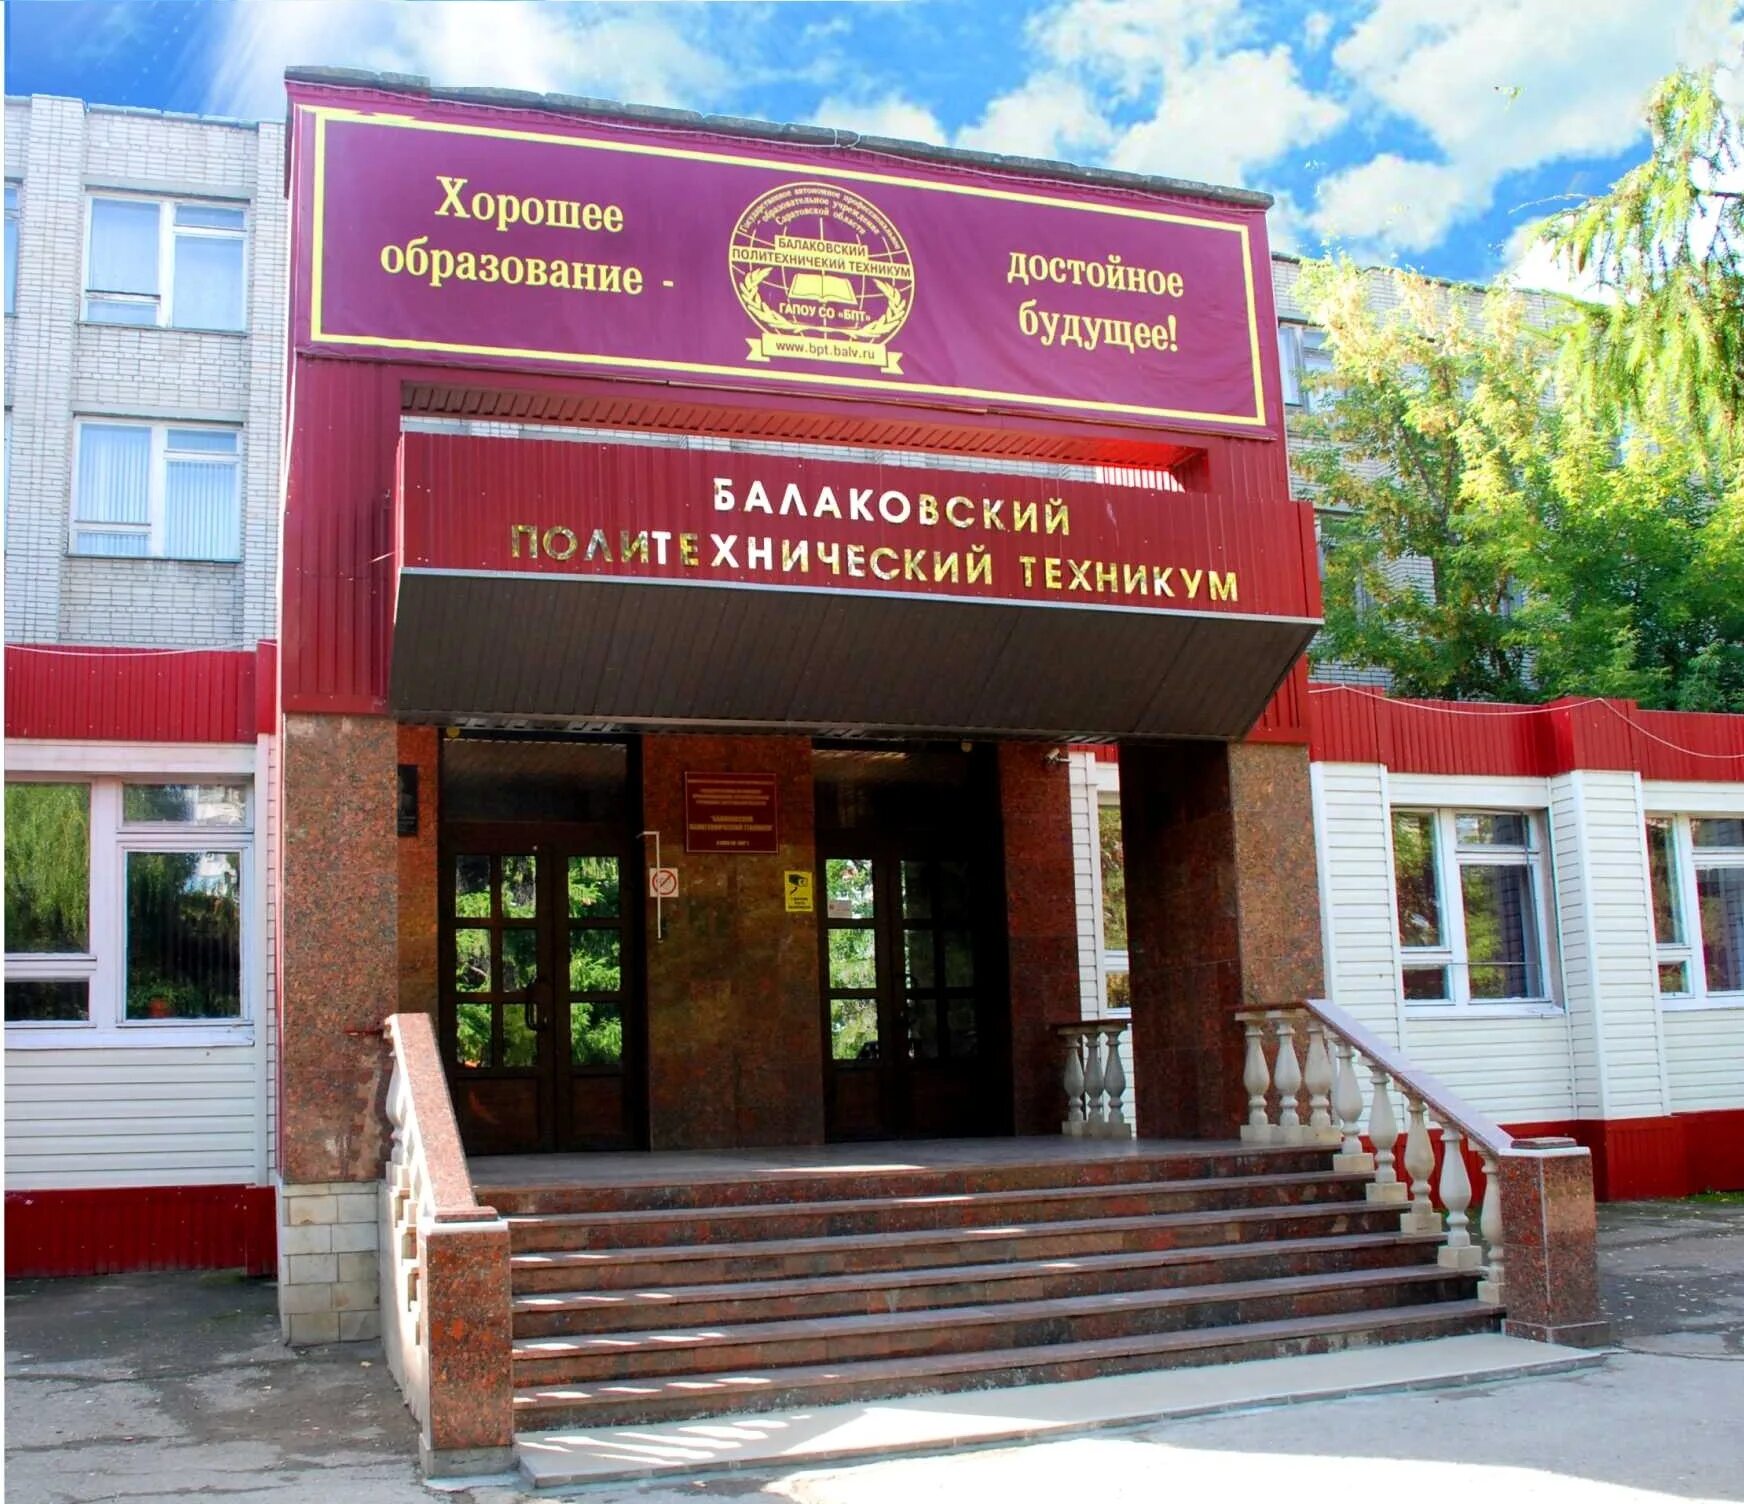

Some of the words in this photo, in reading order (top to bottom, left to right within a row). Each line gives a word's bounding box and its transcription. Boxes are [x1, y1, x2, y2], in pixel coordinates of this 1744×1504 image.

[434, 175, 624, 233] Хорошее
[380, 235, 643, 295] образование
[849, 260, 911, 278] ТЕХНИКУМ
[1007, 252, 1184, 297] достойное
[779, 303, 817, 317] ГАПОУ
[818, 307, 835, 319] СО
[1019, 299, 1178, 354] будущее!
[776, 341, 875, 360] www.bpt.balv.ru
[713, 477, 1070, 536] БАЛАКОВСКИЙ
[511, 524, 993, 585] ПОЛИТЕХНИЧЕСКИЙ
[1019, 554, 1239, 602] ТЕХНИКУМ
